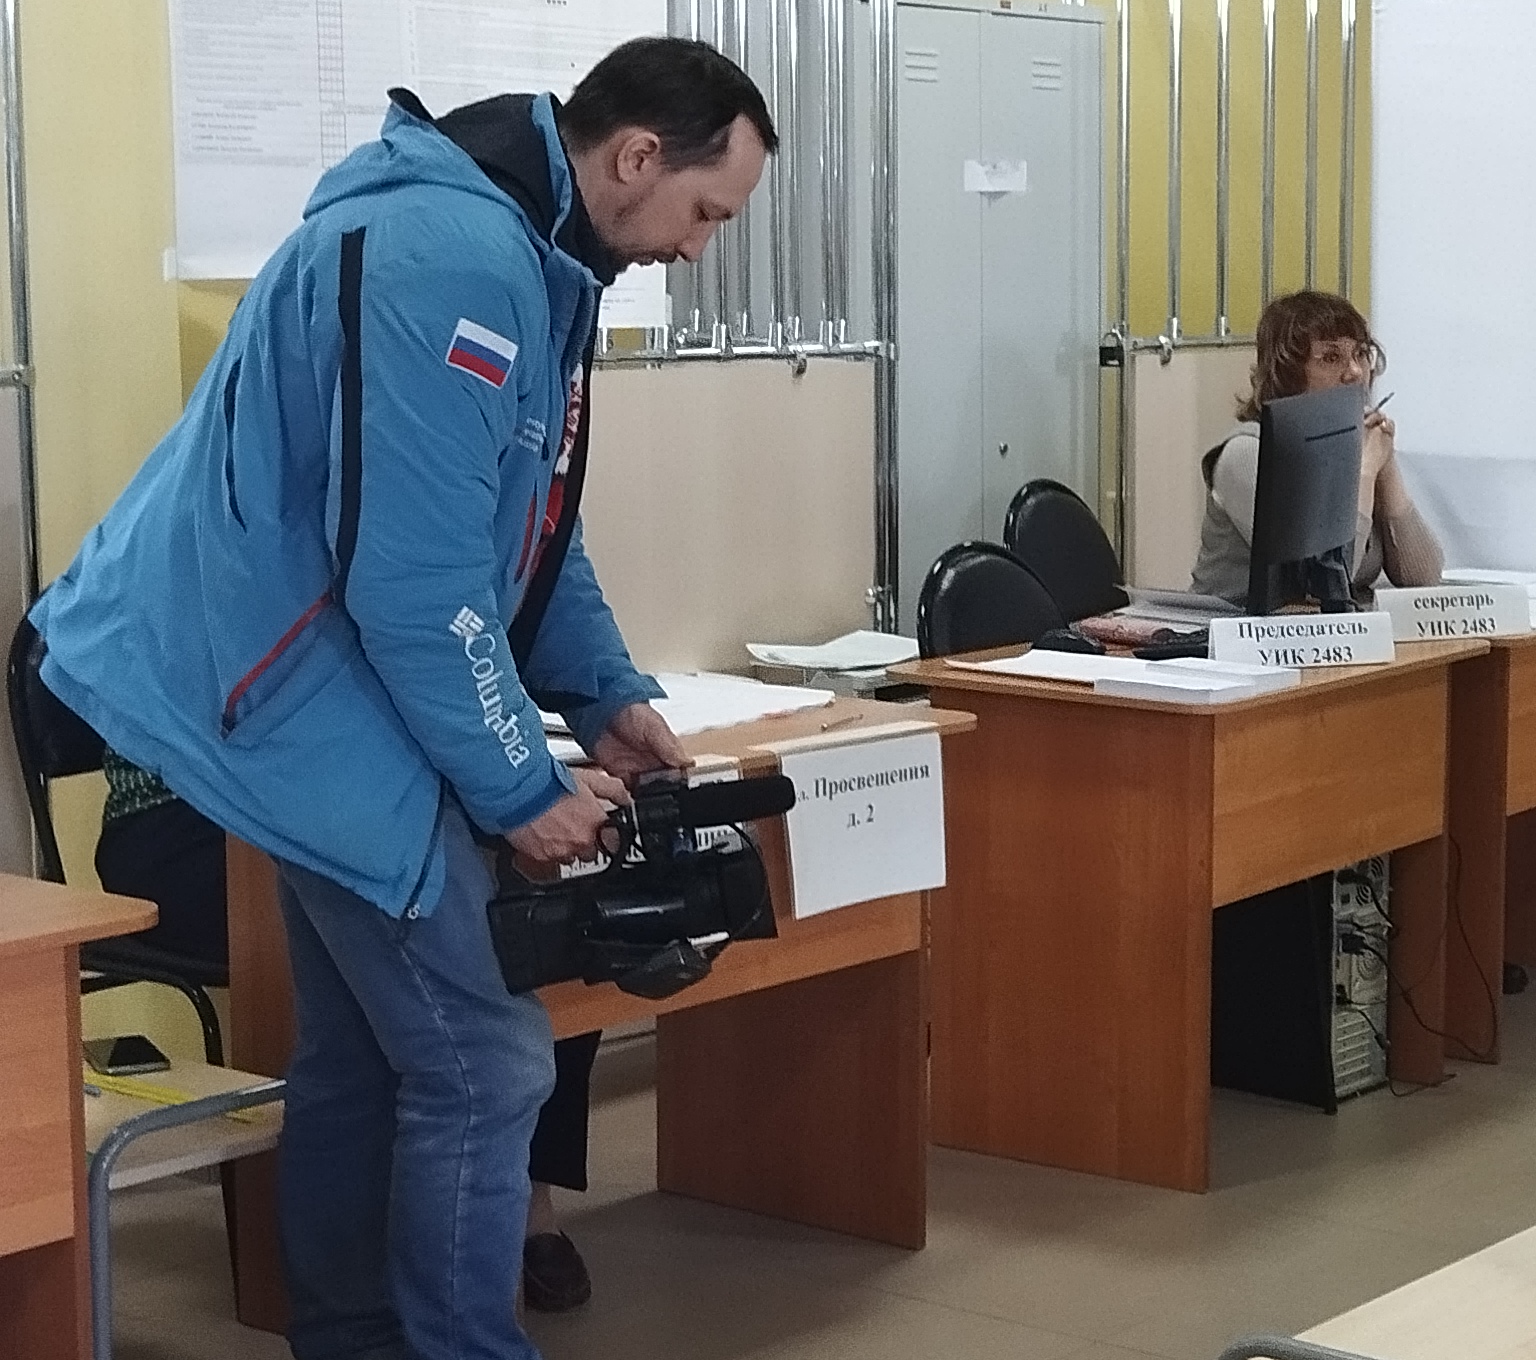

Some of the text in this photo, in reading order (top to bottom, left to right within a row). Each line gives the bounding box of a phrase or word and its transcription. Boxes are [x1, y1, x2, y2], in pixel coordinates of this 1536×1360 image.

[1413, 592, 1494, 610] секретарь
[1237, 617, 1369, 640] Председатель
[1416, 617, 1496, 637] УИК 2483
[1257, 645, 1354, 666] УИК 2483
[465, 633, 531, 769] Columbia
[815, 764, 931, 800] Просвещения
[867, 803, 875, 824] 2
